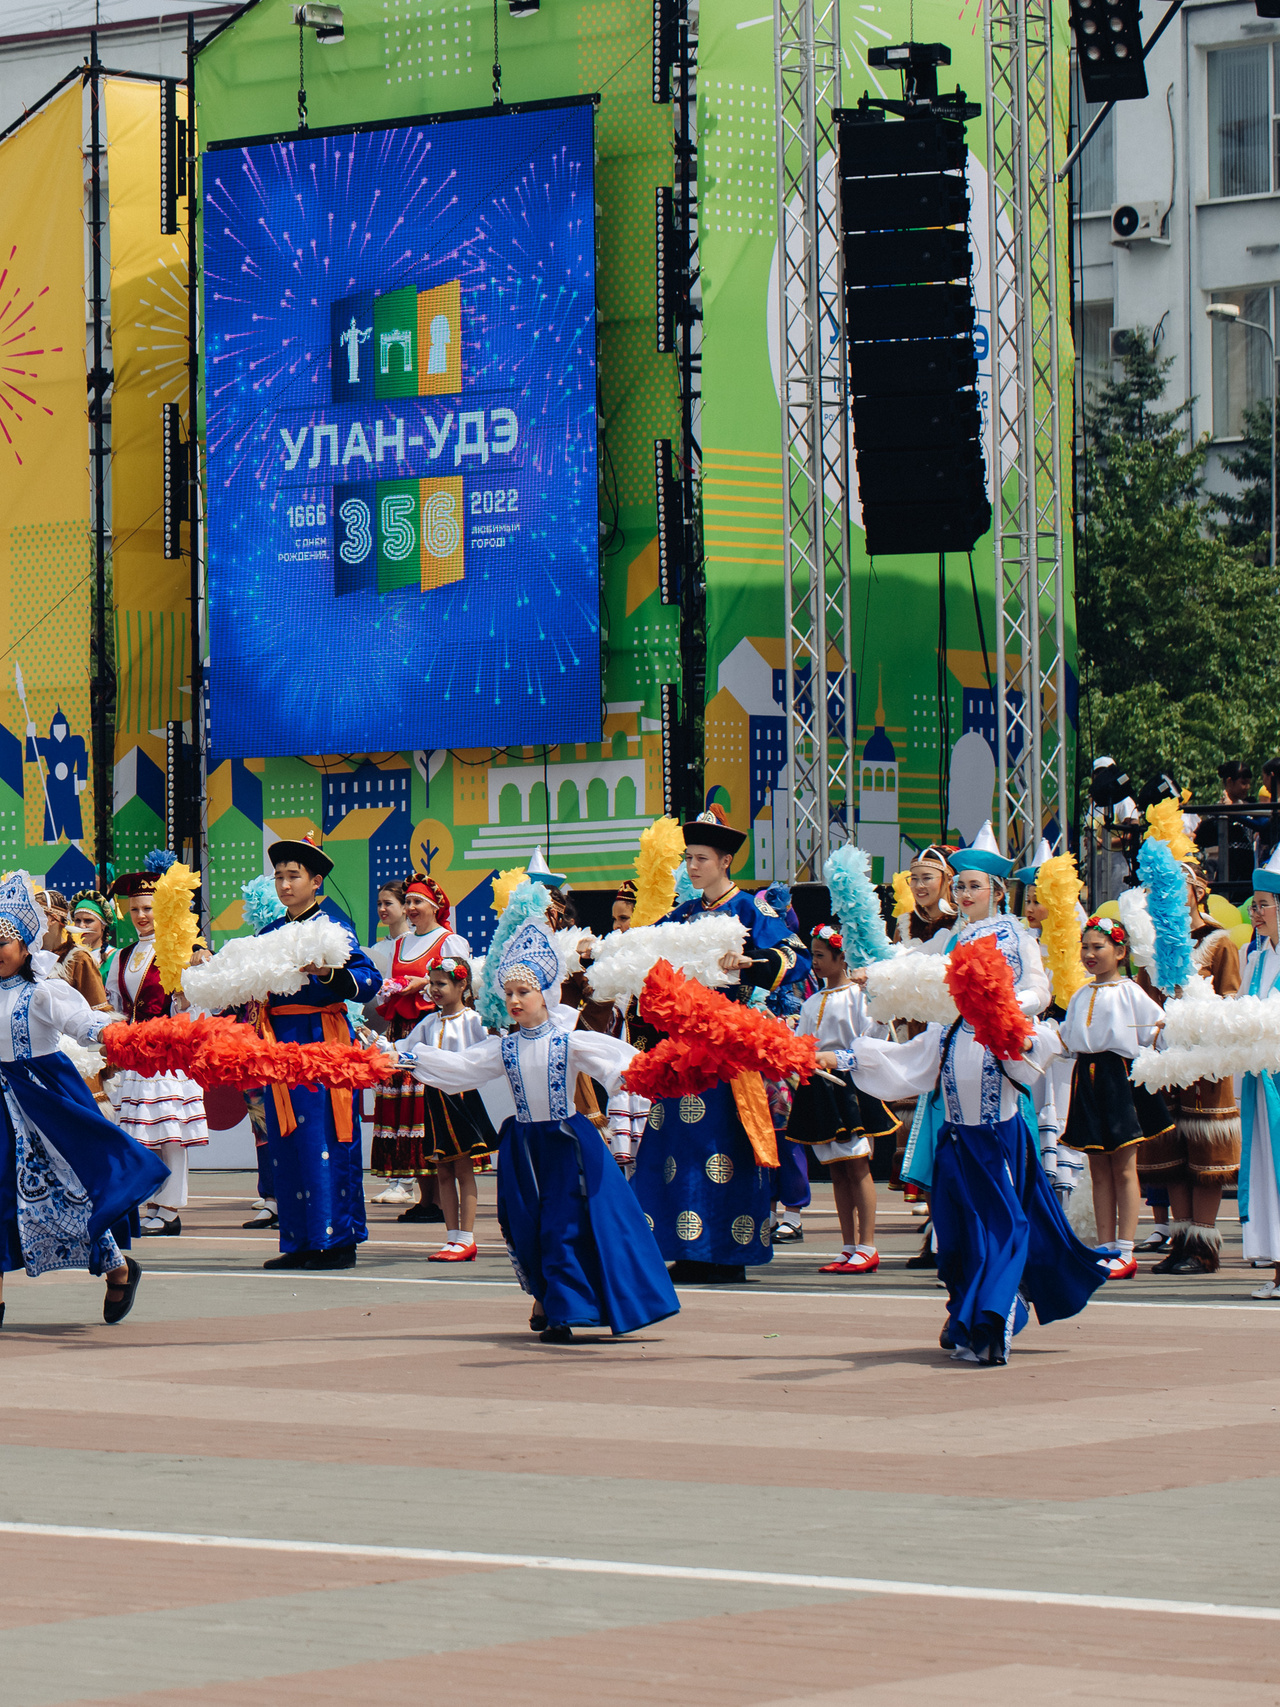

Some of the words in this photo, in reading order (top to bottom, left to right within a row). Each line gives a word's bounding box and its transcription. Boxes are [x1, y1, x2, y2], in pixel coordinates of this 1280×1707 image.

[279, 407, 520, 471] УЛАН-УДЭ
[471, 488, 519, 515] 2022
[286, 503, 327, 528] 1666
[339, 491, 460, 564] 356
[471, 523, 521, 534] ЛЮБИМЫЙ
[295, 539, 302, 548] С
[471, 537, 506, 549] ГОРОД!
